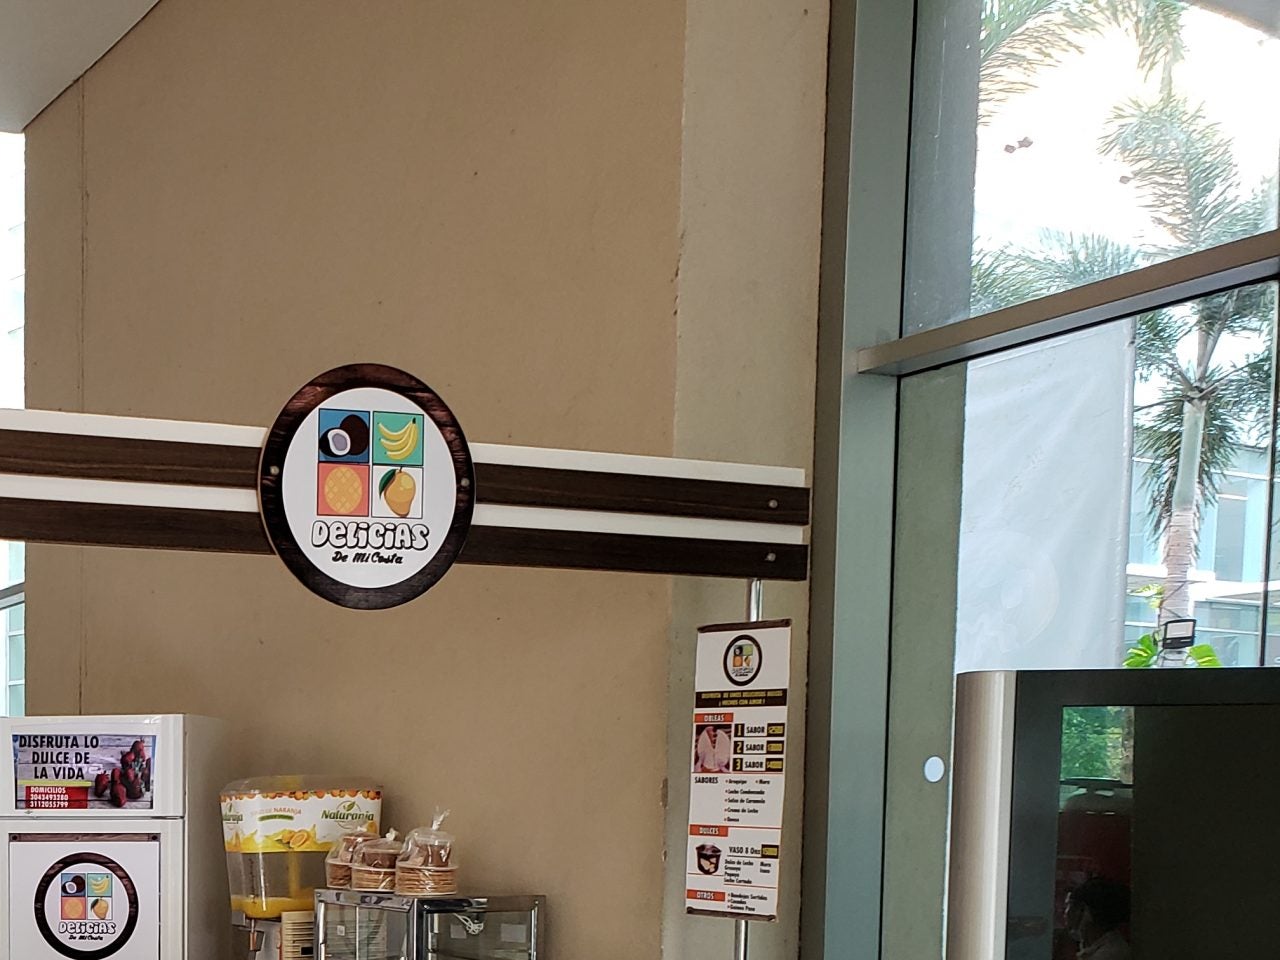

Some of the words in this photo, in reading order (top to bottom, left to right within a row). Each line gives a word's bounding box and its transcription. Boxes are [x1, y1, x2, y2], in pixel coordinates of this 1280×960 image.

[331, 551, 348, 563] De
[371, 551, 404, 565] Costa
[746, 726, 765, 734] SABOR
[20, 735, 79, 748] DISFRUTA
[84, 735, 99, 748] LO
[736, 742, 742, 753] 2
[32, 751, 72, 764] DULCE
[75, 752, 90, 764] DE
[735, 759, 741, 770] 3
[745, 761, 763, 769] SABOR
[34, 767, 48, 779] LA
[53, 767, 85, 780] VIDA
[729, 846, 743, 854] VASO
